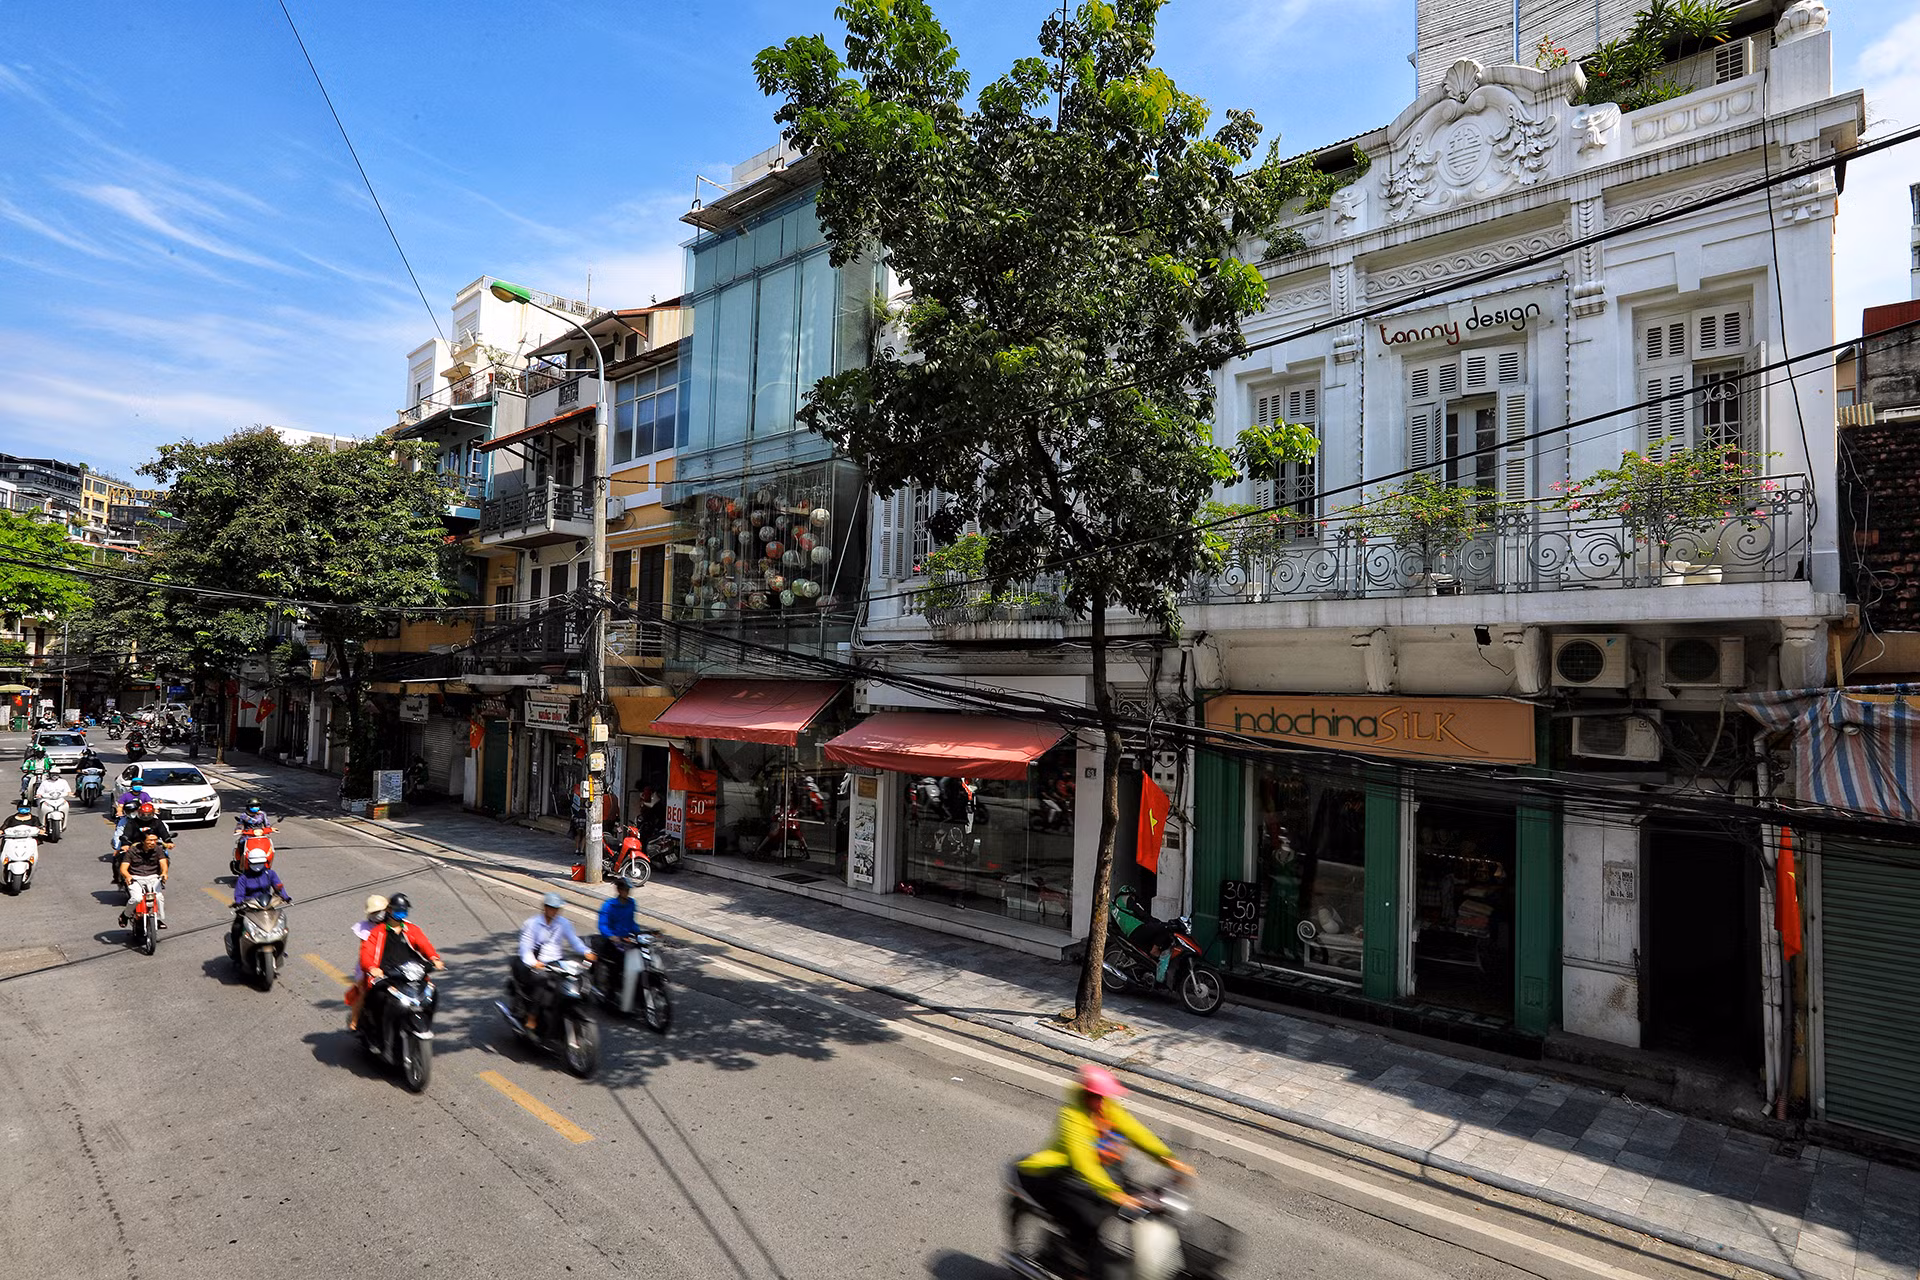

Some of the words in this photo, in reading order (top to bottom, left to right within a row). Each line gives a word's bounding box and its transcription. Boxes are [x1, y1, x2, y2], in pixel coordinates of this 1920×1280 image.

[1379, 320, 1461, 346] tanmy
[1465, 303, 1541, 332] design
[109, 487, 137, 499] MAY
[1235, 706, 1378, 737] indochina
[667, 804, 682, 823] BÉO
[690, 800, 705, 815] 50
